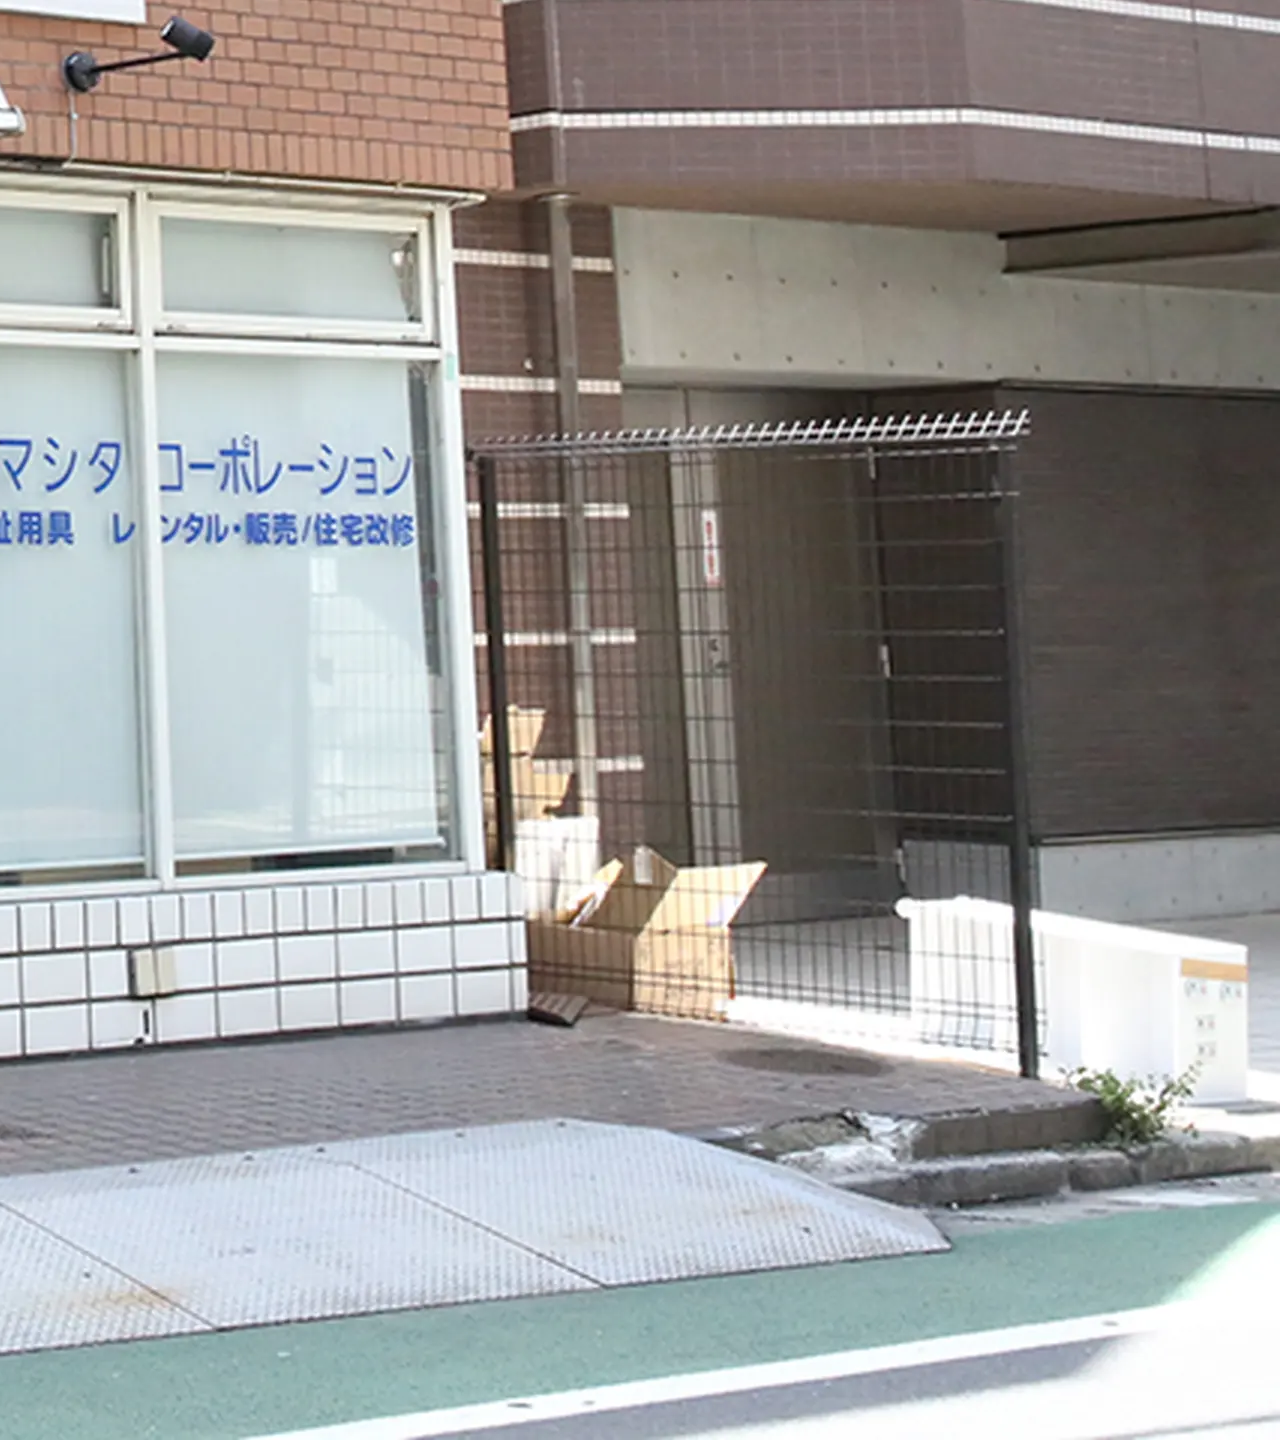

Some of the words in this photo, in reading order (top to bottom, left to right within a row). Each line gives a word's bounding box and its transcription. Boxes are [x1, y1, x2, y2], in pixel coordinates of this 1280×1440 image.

[158, 434, 413, 496] コーポレーション
